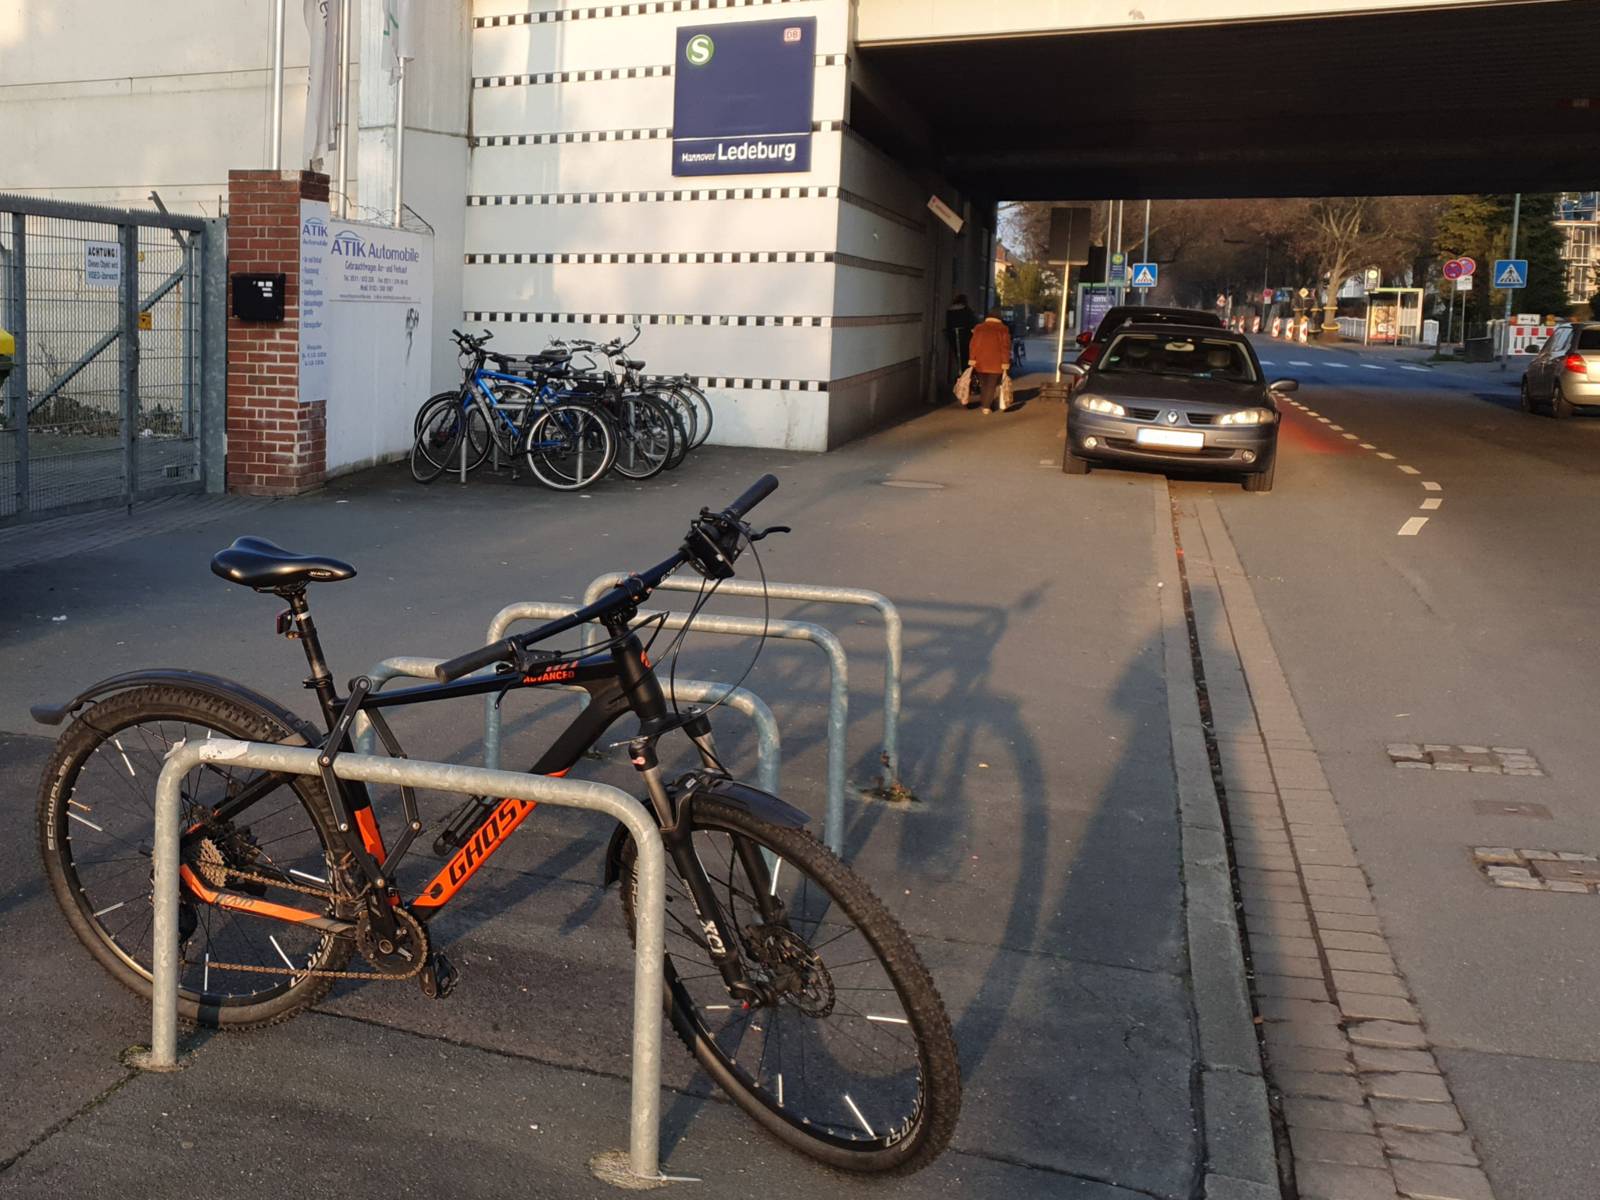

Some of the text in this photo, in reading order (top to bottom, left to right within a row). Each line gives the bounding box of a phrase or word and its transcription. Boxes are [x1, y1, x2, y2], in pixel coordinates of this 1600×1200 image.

[785, 29, 800, 40] DB
[691, 38, 710, 63] S
[682, 141, 797, 163] Hannover Ledeburg
[302, 224, 328, 237] ATIK
[88, 246, 119, 258] ACHTUNG!
[331, 239, 420, 263] ATIK Automobile
